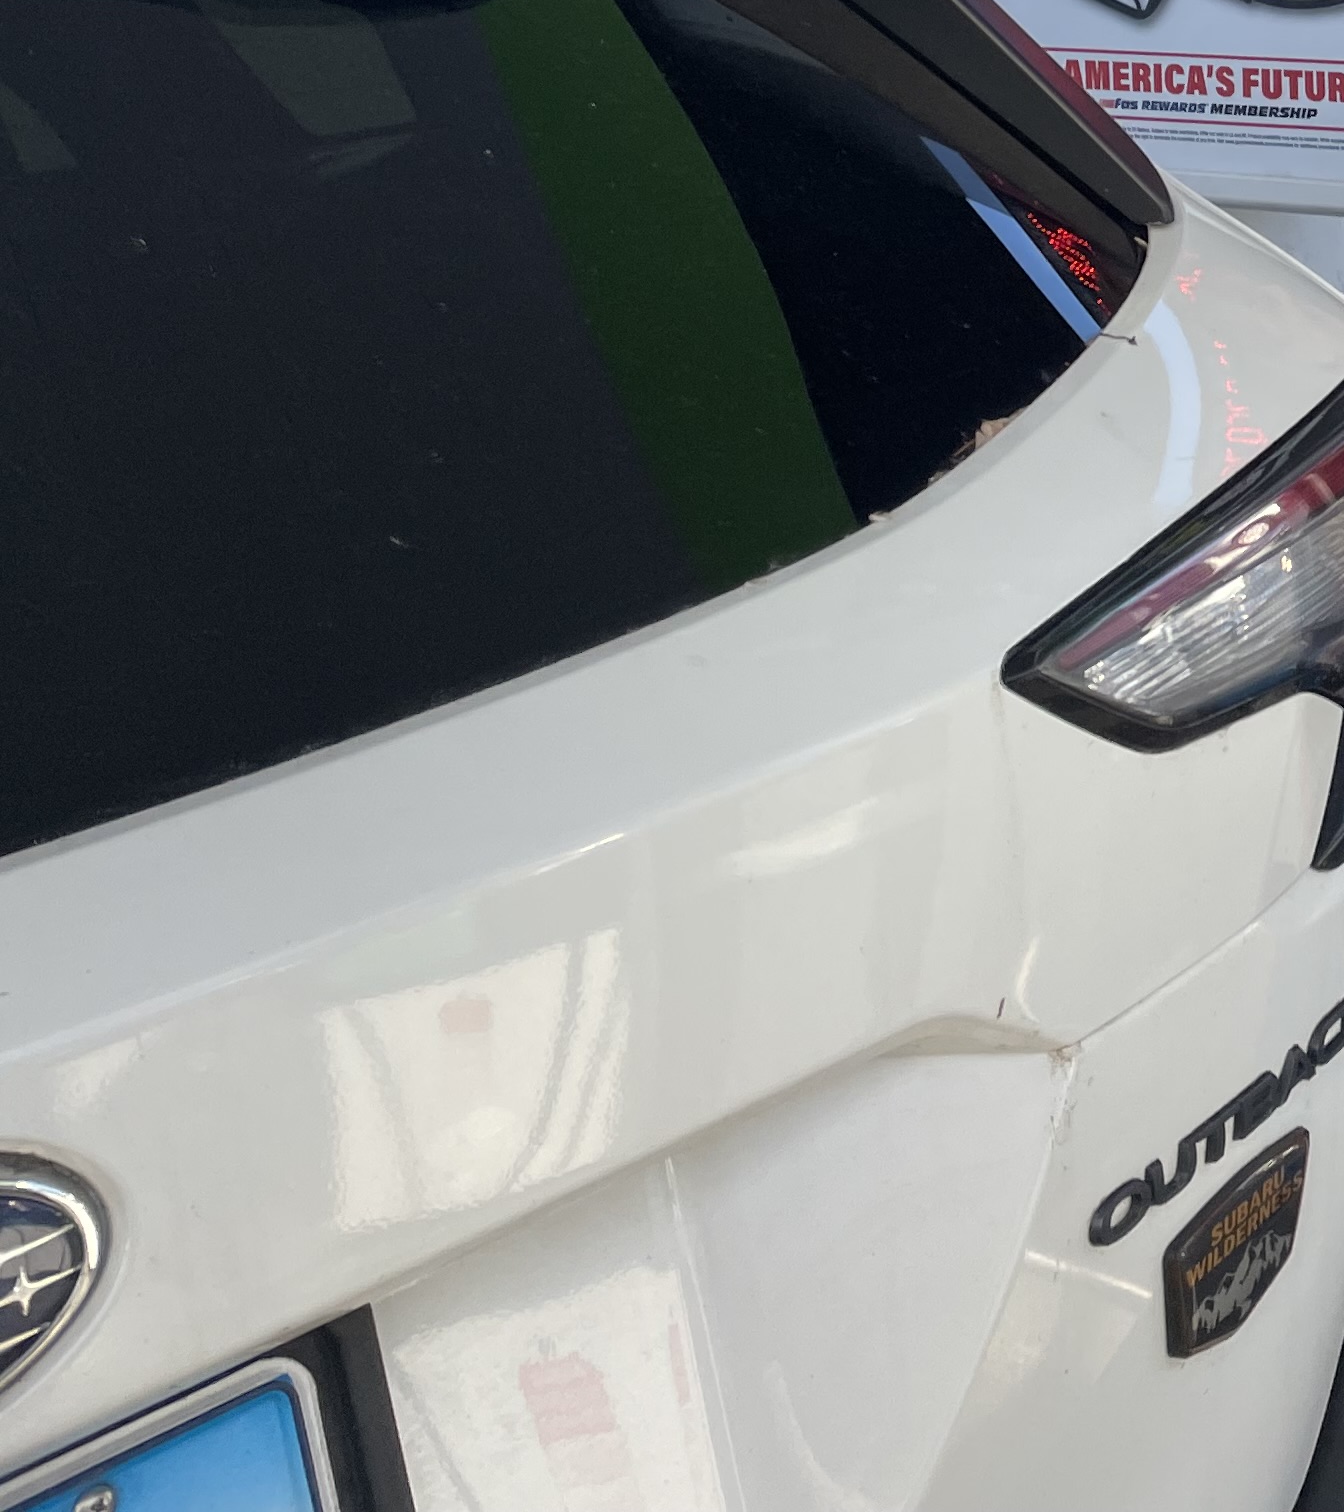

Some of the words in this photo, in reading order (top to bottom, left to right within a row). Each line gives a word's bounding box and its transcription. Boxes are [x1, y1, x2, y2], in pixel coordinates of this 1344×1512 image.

[1065, 59, 1234, 98] AMERICA'S
[1210, 103, 1318, 119] MEMBERSHIP
[1186, 1170, 1304, 1286] WILDERNESS
[1210, 1165, 1285, 1247] SUBARU
